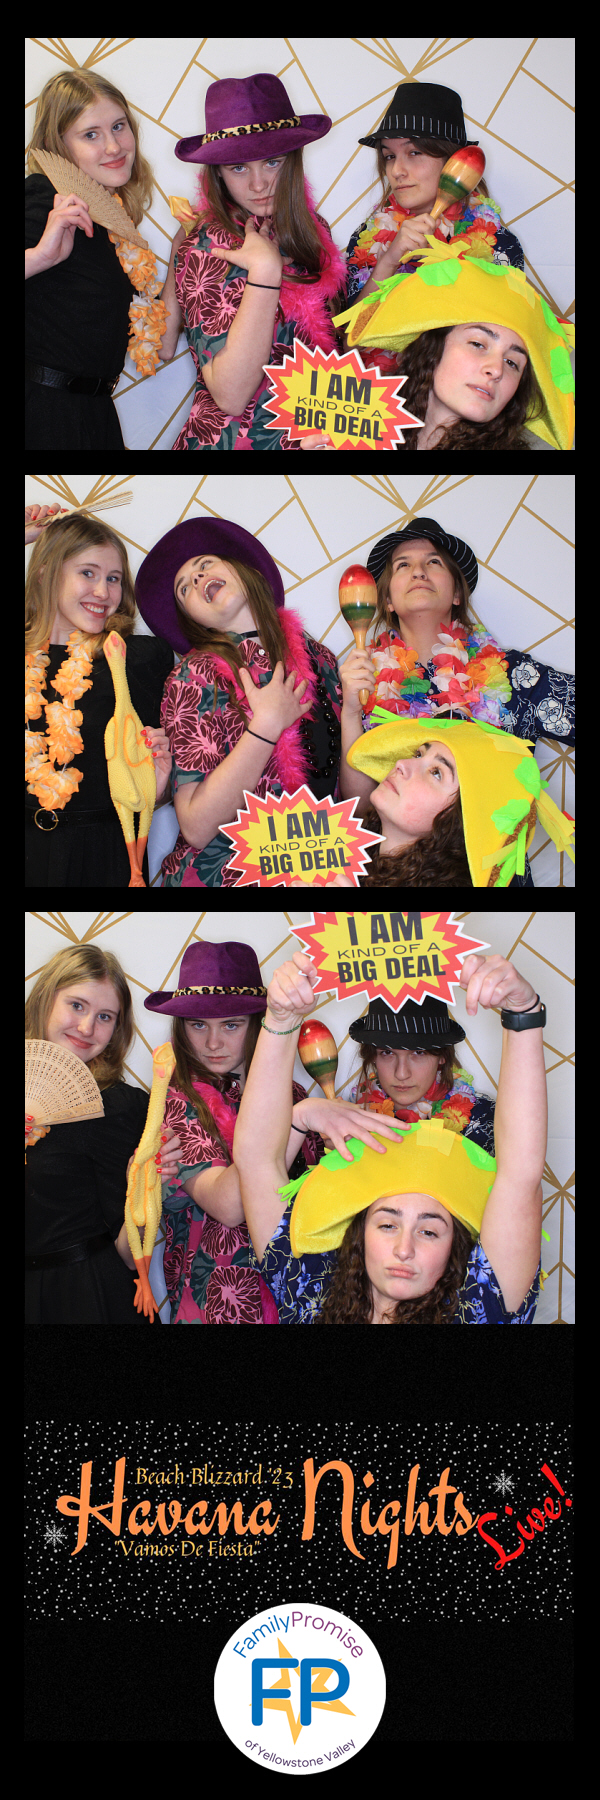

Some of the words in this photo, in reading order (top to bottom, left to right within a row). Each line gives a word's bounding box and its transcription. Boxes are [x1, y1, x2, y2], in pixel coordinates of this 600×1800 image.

[310, 370, 318, 396] I
[326, 373, 372, 405] AM
[297, 396, 338, 410] KIND
[343, 405, 367, 415] OF
[371, 410, 382, 419] A
[294, 406, 327, 431] BIG
[334, 413, 383, 441] DEAL
[267, 816, 277, 842] I
[286, 809, 330, 840] AM
[260, 842, 300, 854] KIND
[306, 838, 328, 849] OF
[334, 837, 345, 845] A
[259, 854, 294, 876] BIG
[299, 847, 351, 871] DEAL
[347, 916, 359, 946] I
[371, 912, 423, 944] AM
[338, 947, 386, 959] KIND
[393, 944, 421, 955] OF
[427, 942, 441, 952] A
[337, 960, 377, 984] BIG
[385, 954, 446, 980] DEAL
